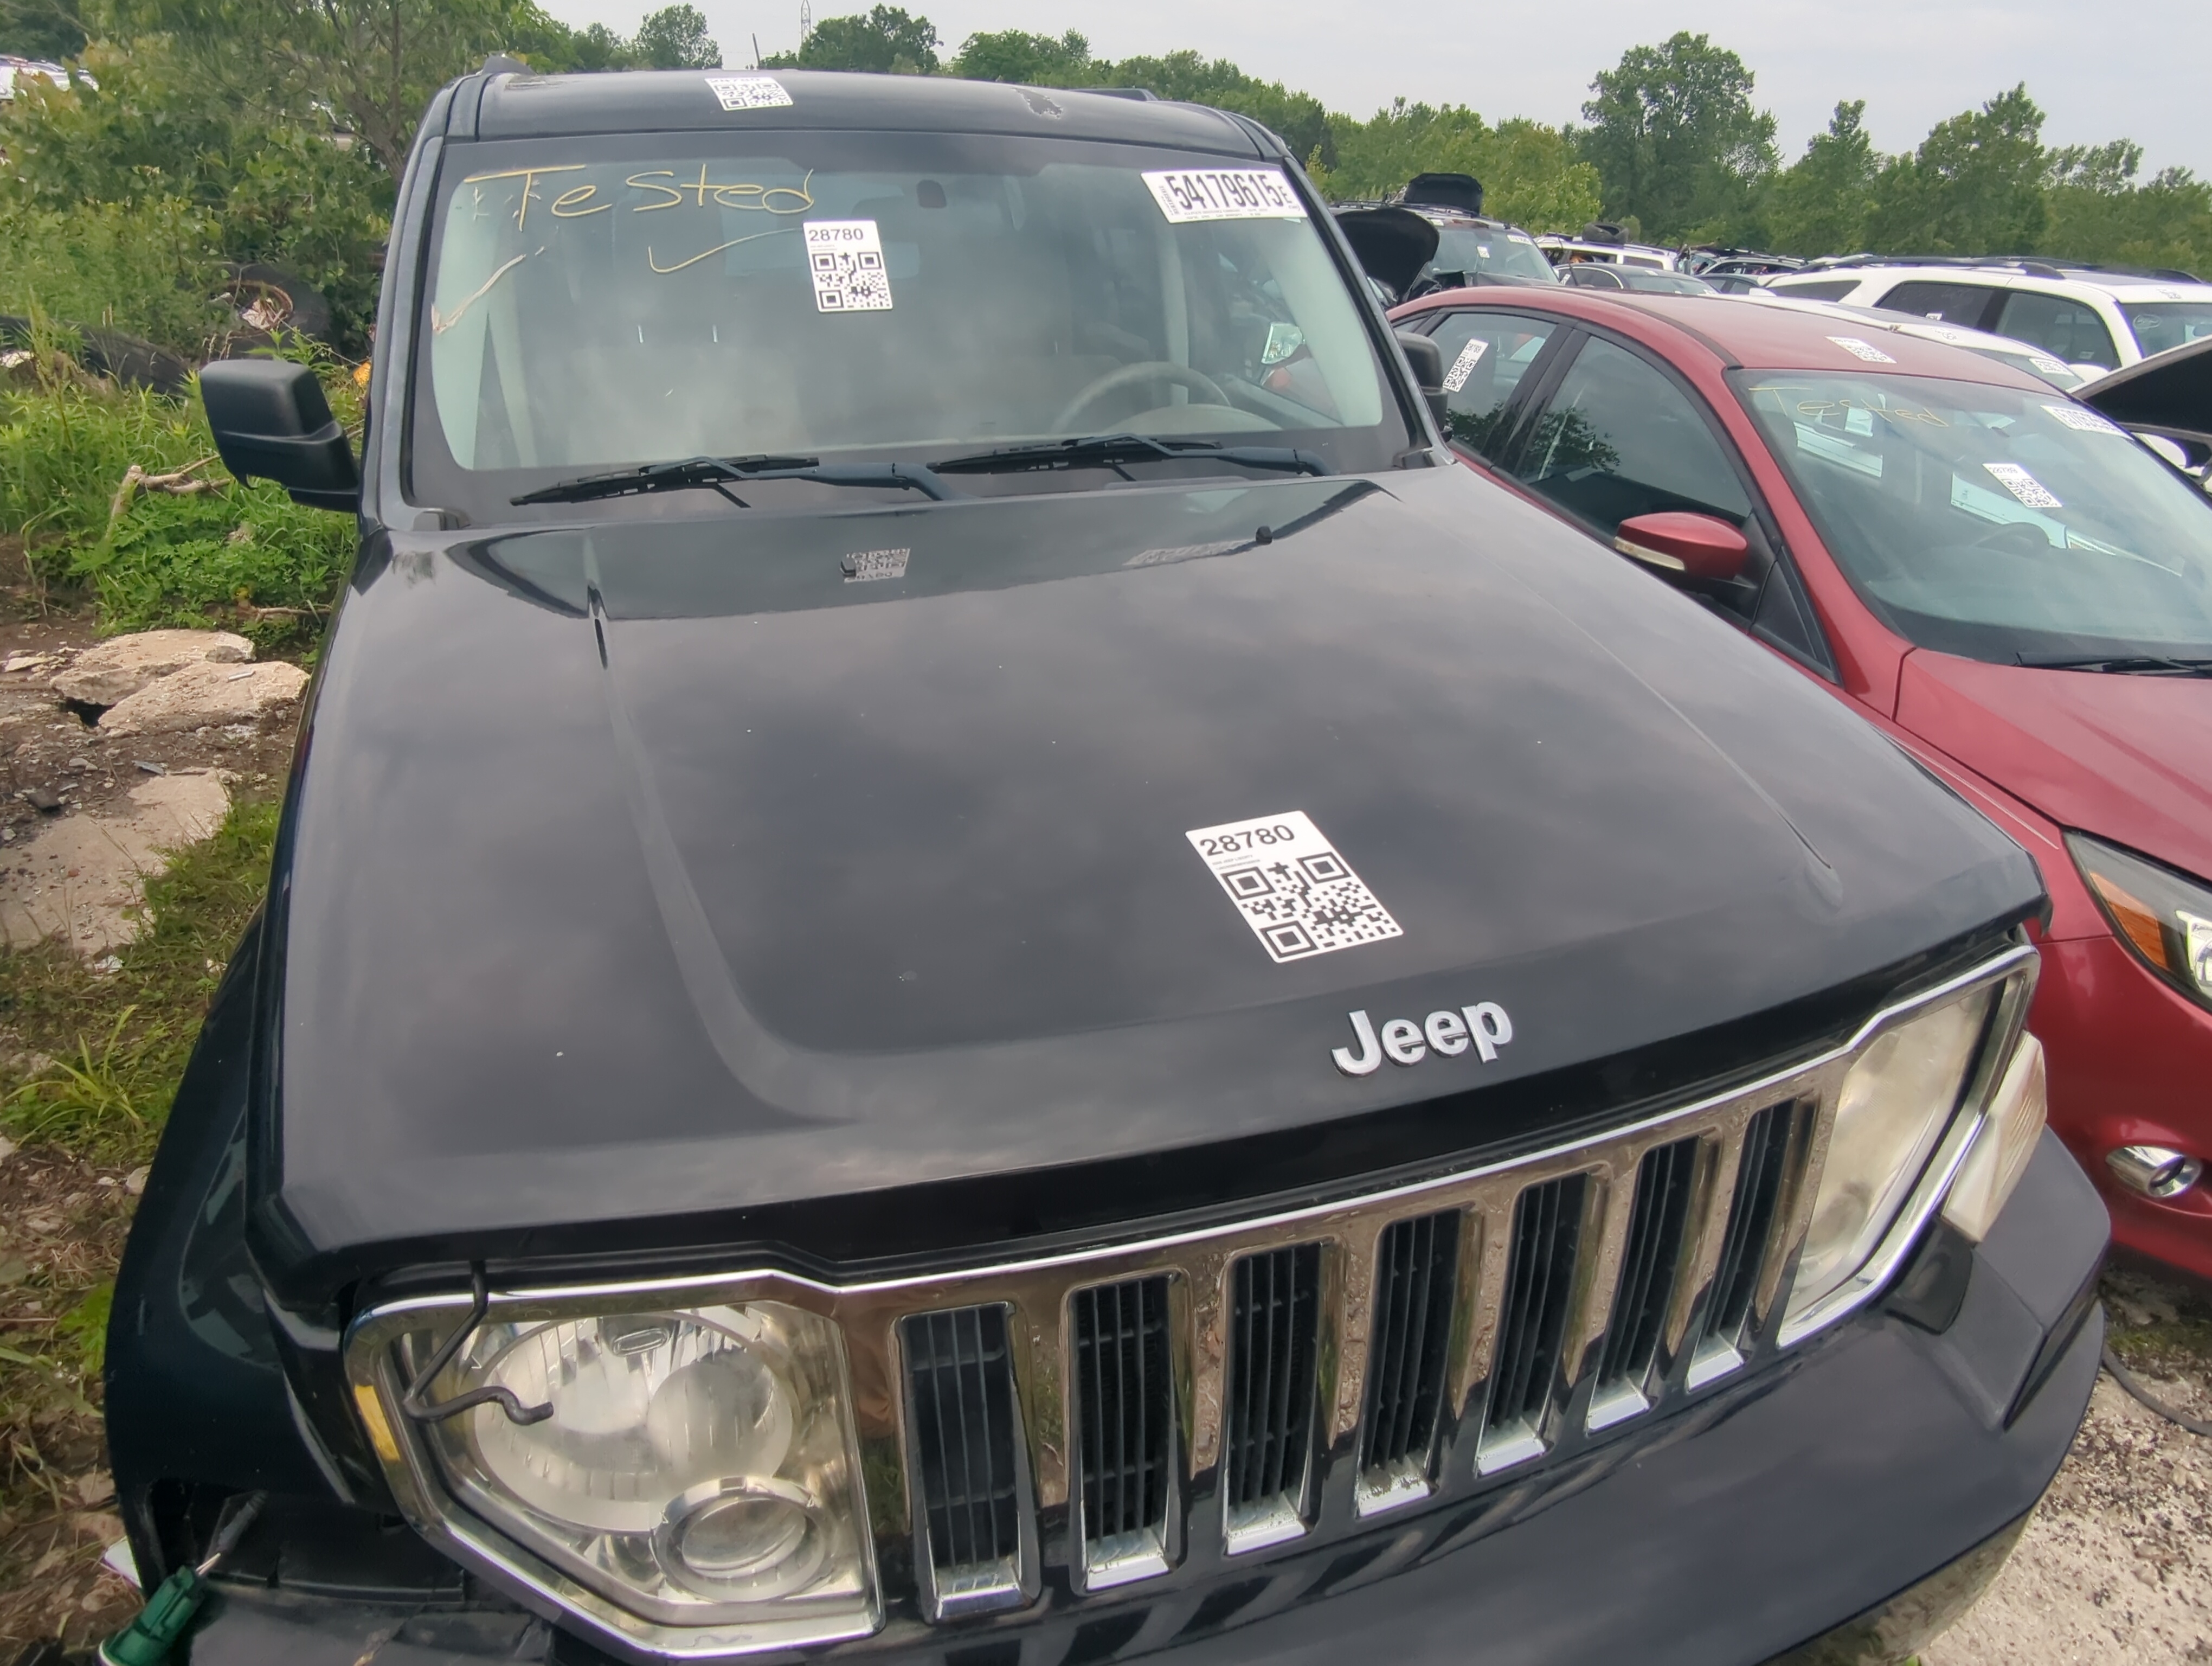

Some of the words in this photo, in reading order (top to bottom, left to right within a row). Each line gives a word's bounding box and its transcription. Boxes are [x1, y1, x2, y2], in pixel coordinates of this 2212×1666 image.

[1163, 173, 1284, 210] 54179615
[808, 228, 864, 242] 28780
[1199, 824, 1295, 856] 28780
[1330, 1001, 1513, 1077] Jeep
